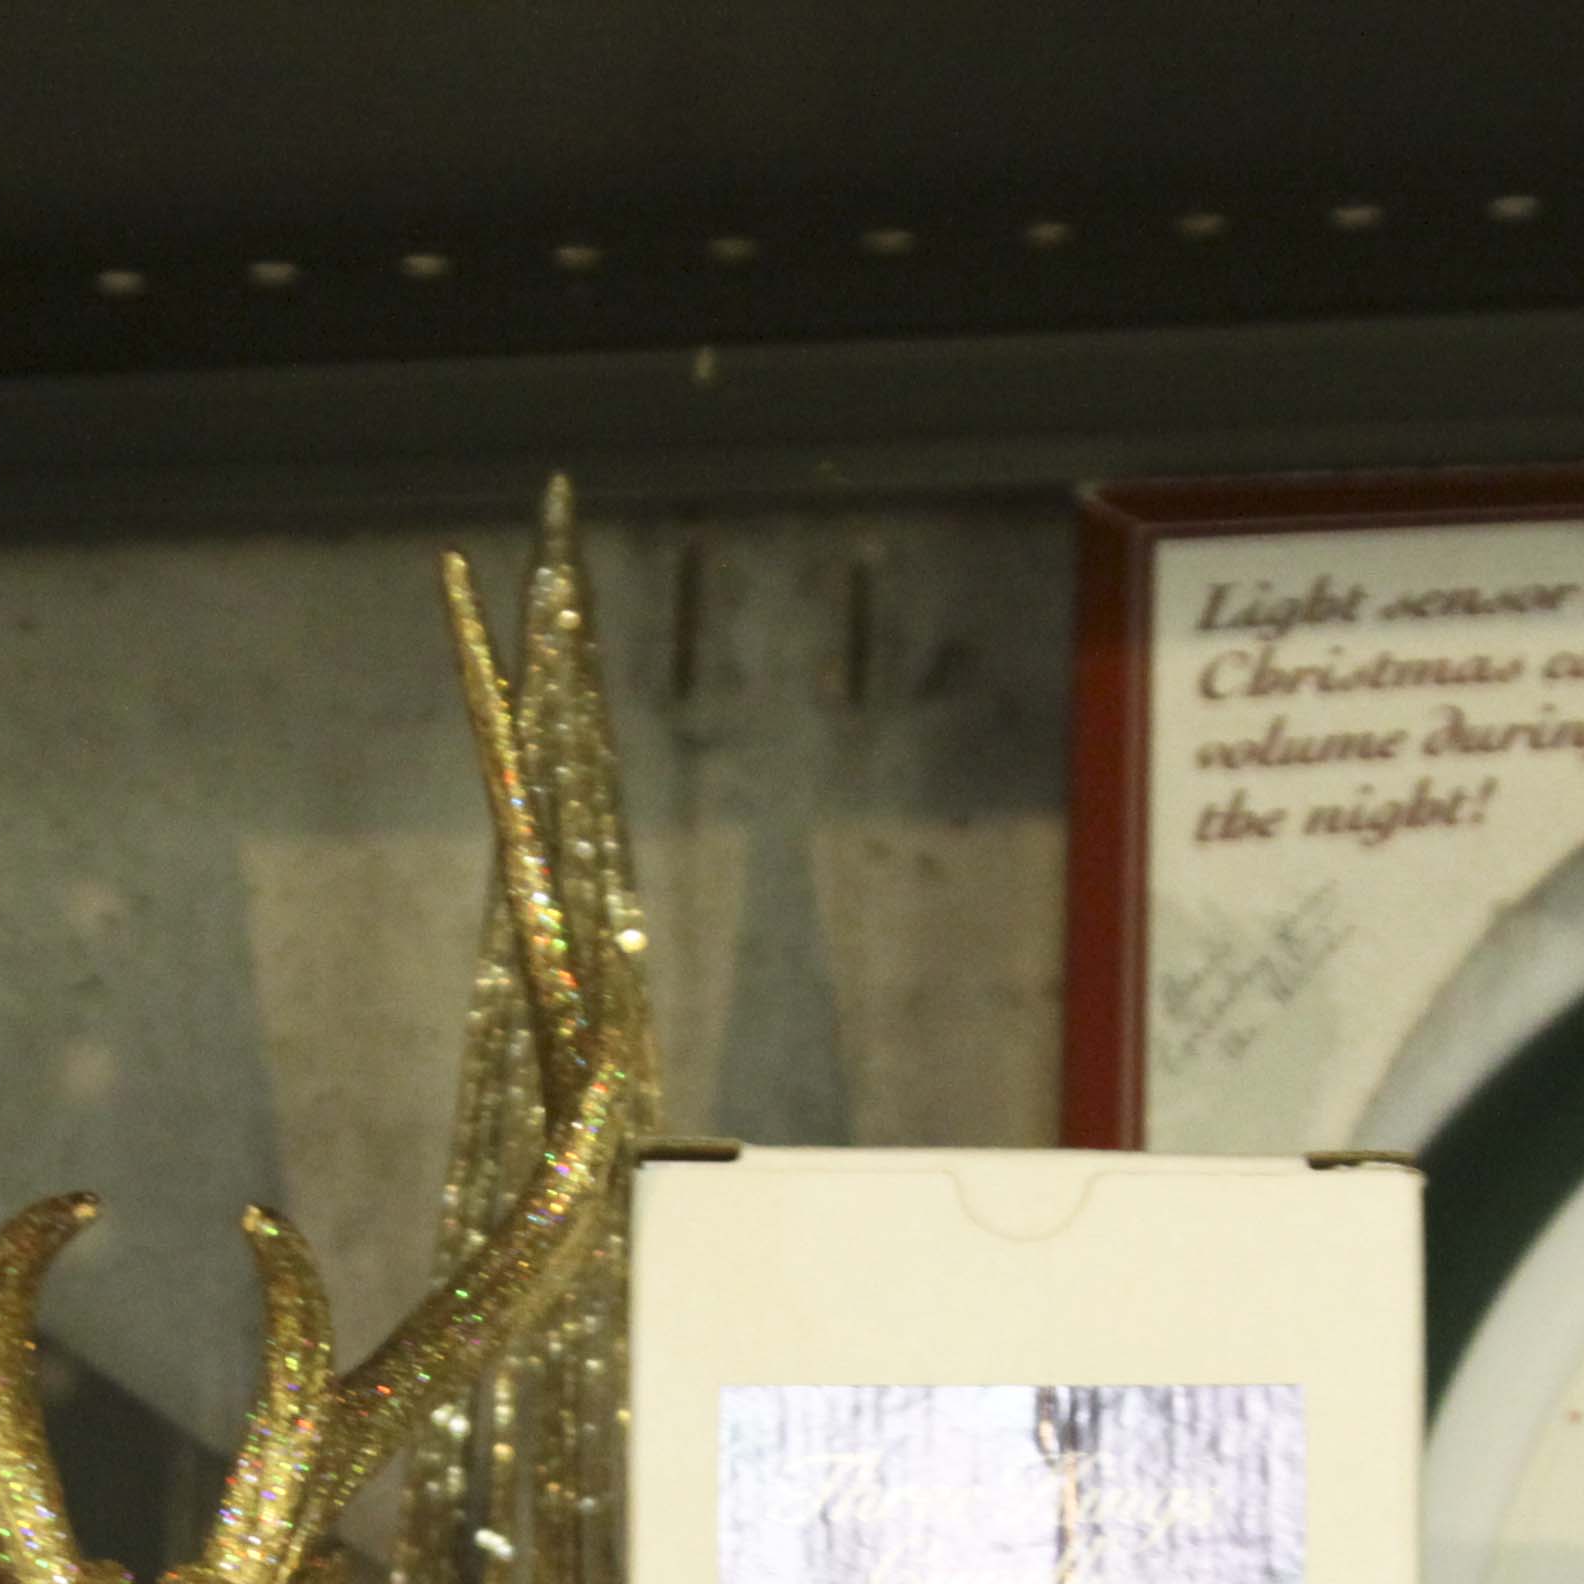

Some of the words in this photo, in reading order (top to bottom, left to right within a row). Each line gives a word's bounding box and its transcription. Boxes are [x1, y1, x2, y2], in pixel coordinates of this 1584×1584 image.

[1196, 573, 1367, 643] Light
[1373, 581, 1580, 621] sensor
[1197, 644, 1522, 702] Christmas
[1196, 714, 1408, 770] volume
[1196, 786, 1287, 843] the
[1302, 775, 1498, 847] night!
